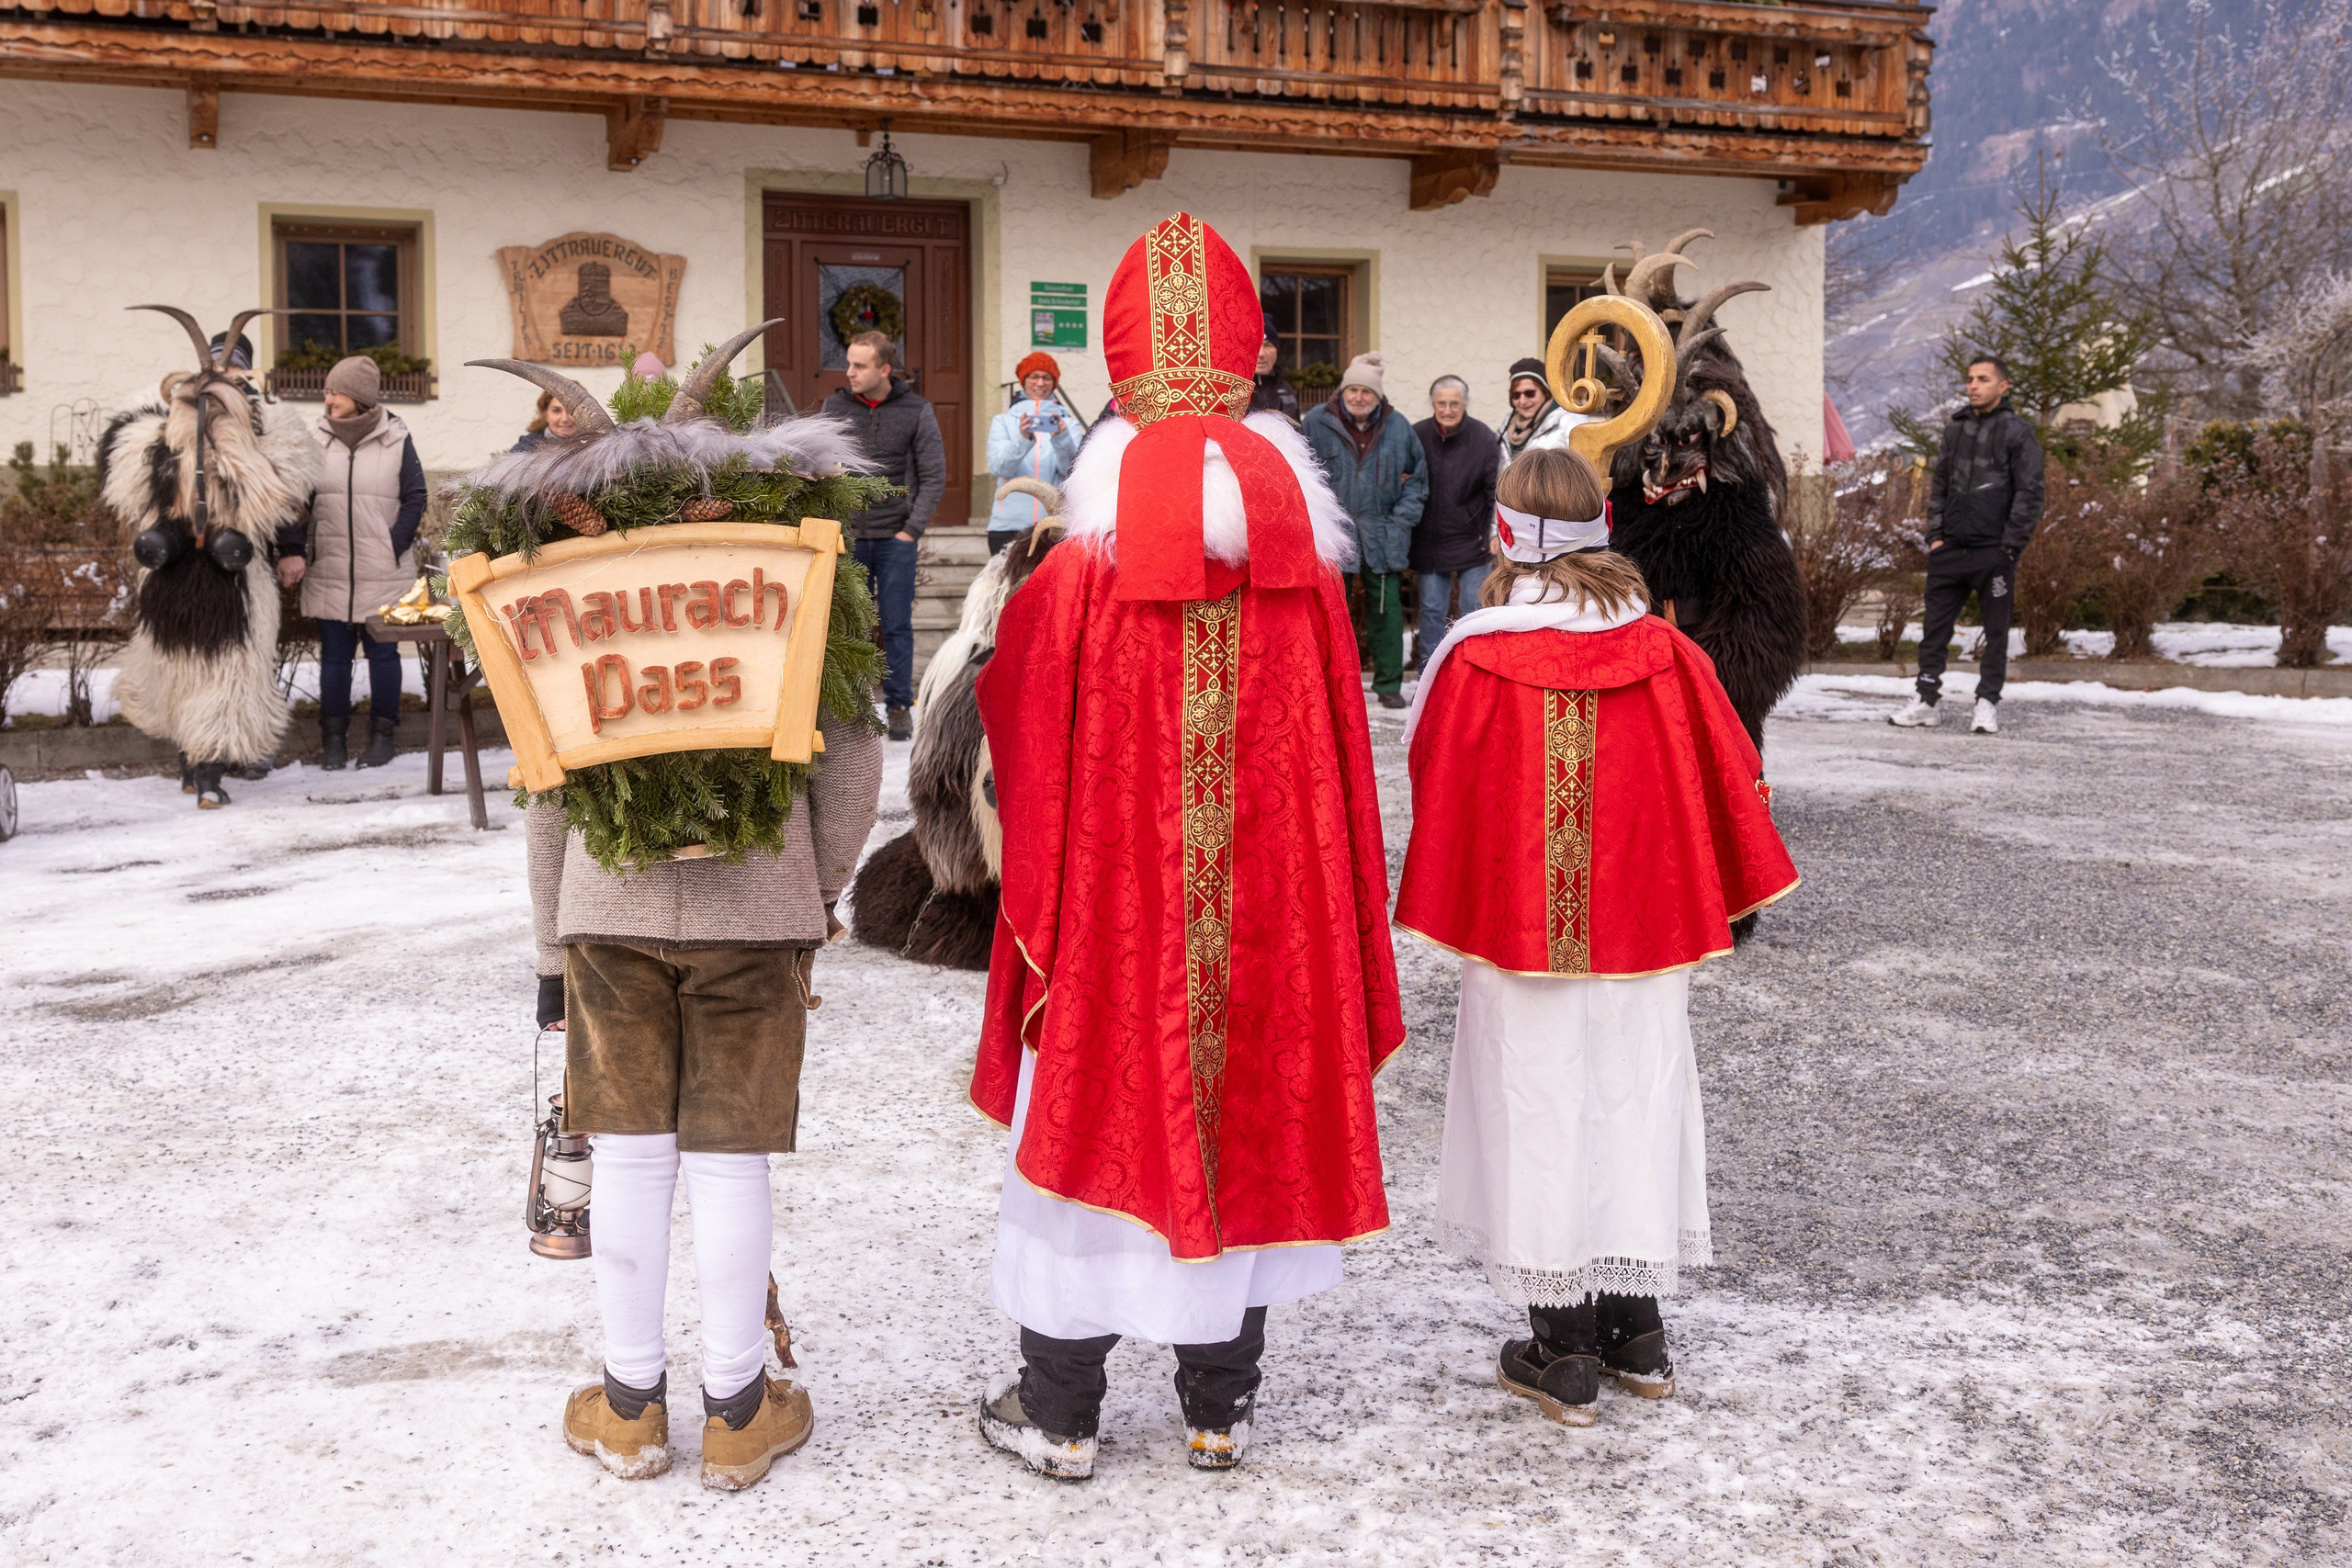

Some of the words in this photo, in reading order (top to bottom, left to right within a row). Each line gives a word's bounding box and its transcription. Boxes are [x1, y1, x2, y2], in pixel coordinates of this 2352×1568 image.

[527, 238, 659, 280] ZITTRAUERGUT
[552, 342, 594, 359] SEIT
[500, 567, 789, 662] Maurach
[581, 653, 742, 735] Pass
